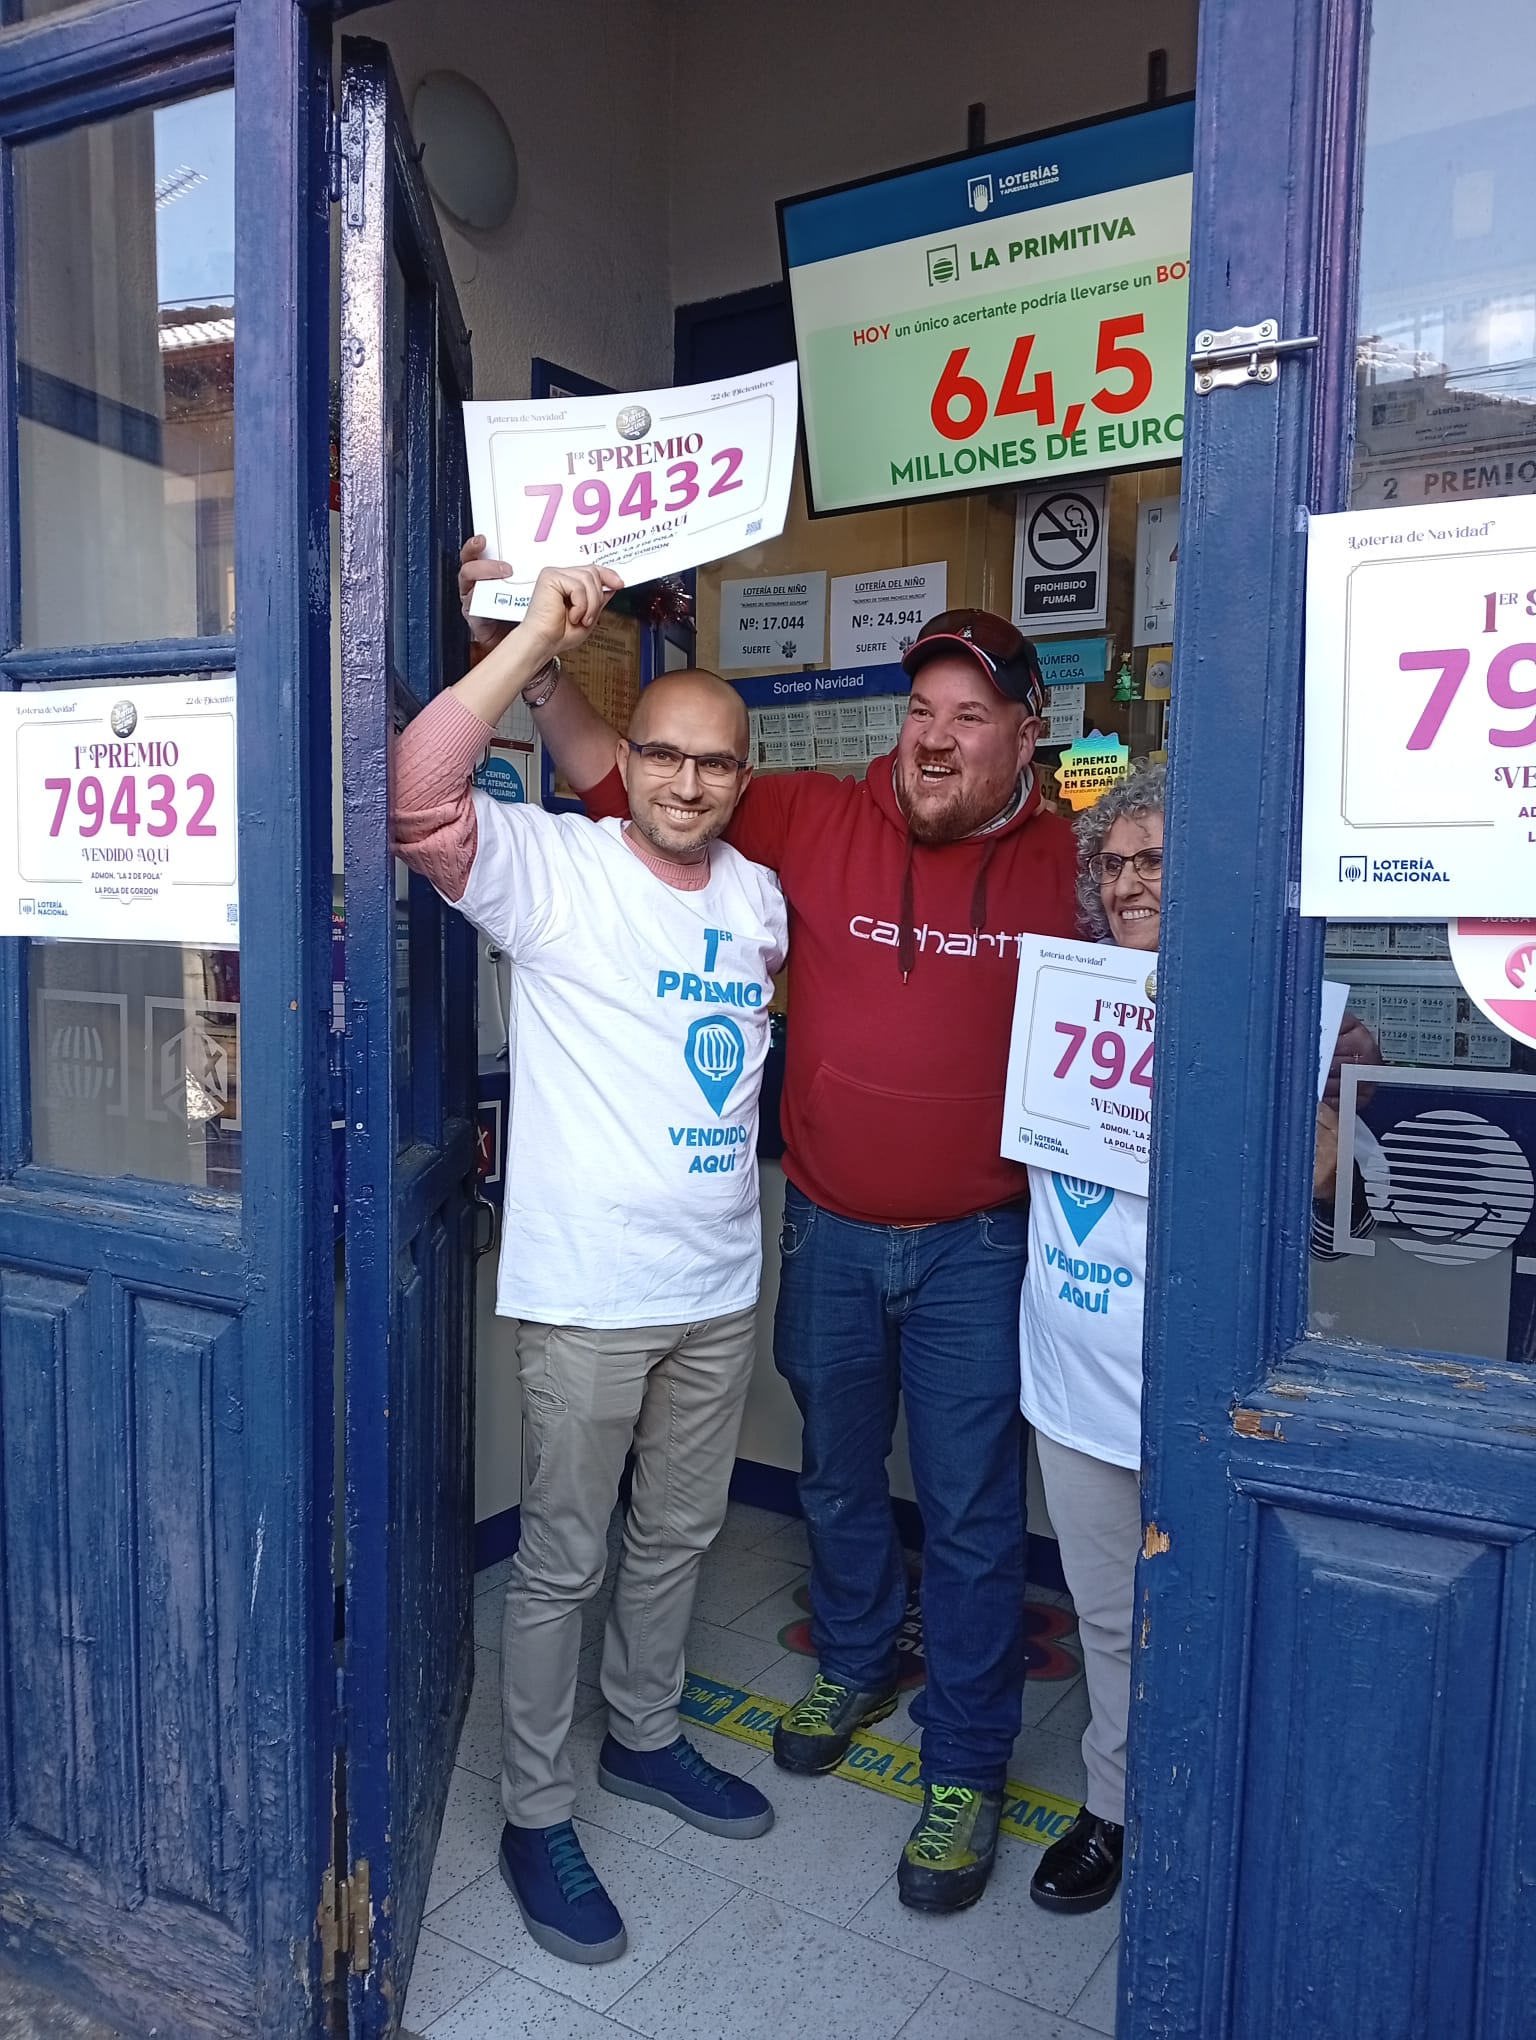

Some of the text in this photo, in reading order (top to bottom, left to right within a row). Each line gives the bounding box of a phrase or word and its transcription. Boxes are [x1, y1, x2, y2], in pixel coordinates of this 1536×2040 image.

[998, 164, 1059, 188] LOTERÍAS
[1005, 185, 1028, 194] APUESTAS
[1039, 176, 1060, 187] ESTADO
[970, 216, 1136, 272] LA PRIMITIVA
[853, 260, 1190, 346] HOY un único acertante podría llevarse un BO
[930, 313, 1153, 441] 64,5
[710, 379, 775, 401] 22 de Diciembre
[520, 414, 529, 422] de
[530, 410, 567, 421] Navidad
[588, 432, 704, 472] PREMIO
[890, 437, 1037, 485] MILLONES
[1046, 430, 1088, 460] DE
[523, 446, 744, 543] 79432
[1406, 530, 1425, 543] de
[1428, 520, 1496, 540] Navidad
[580, 528, 647, 556] VENDIDO
[743, 584, 807, 597] LOTERÍA DEL NIÑO
[855, 576, 926, 594] LOTERÍA DEL NIÑO
[1033, 580, 1087, 592] PROHIBIDO
[1042, 594, 1077, 605] FUMAR
[762, 616, 805, 630] 17.044
[877, 608, 923, 627] 24.941
[742, 645, 771, 655] SUERTE
[856, 642, 887, 653] SUERTE
[1038, 653, 1080, 666] NÚMERO
[1046, 668, 1085, 679] LA CASA
[773, 673, 864, 695] Sorteo Navidad
[89, 741, 179, 769] PREMIO
[1072, 755, 1117, 766] ¡PREMIO
[485, 770, 511, 780] CENTRO
[1064, 766, 1125, 777] ENTREGADO
[477, 777, 518, 789] DE ATENCIÓN
[1065, 780, 1077, 789] EN
[489, 788, 516, 798] USUARIO
[44, 773, 217, 838] 79432
[81, 844, 170, 865] VENDIDO AQUÍ
[1373, 855, 1435, 870] LOTERÍA
[90, 872, 116, 881] ADMON.
[133, 872, 143, 880] DE
[1373, 870, 1451, 883] NACIONAL
[94, 886, 102, 895] LA
[103, 886, 119, 895] POLA
[120, 887, 130, 895] DE
[37, 900, 63, 909] LOTERÍA
[37, 909, 69, 917] NACIONAL
[1065, 953, 1075, 962] de
[656, 970, 763, 1007] PREMIO
[667, 1125, 747, 1147] VENDIDO
[1100, 1122, 1131, 1137] ADMON.
[1034, 1133, 1063, 1146] LOTERÍA
[1104, 1137, 1114, 1145] LA
[1115, 1139, 1136, 1152] POLA
[1136, 1144, 1147, 1154] DE
[1033, 1141, 1070, 1155] NACIONAL
[688, 1148, 736, 1173] AQUÍ
[1044, 1243, 1133, 1288] VENDIDO
[1058, 1285, 1110, 1314] AQUÍ
